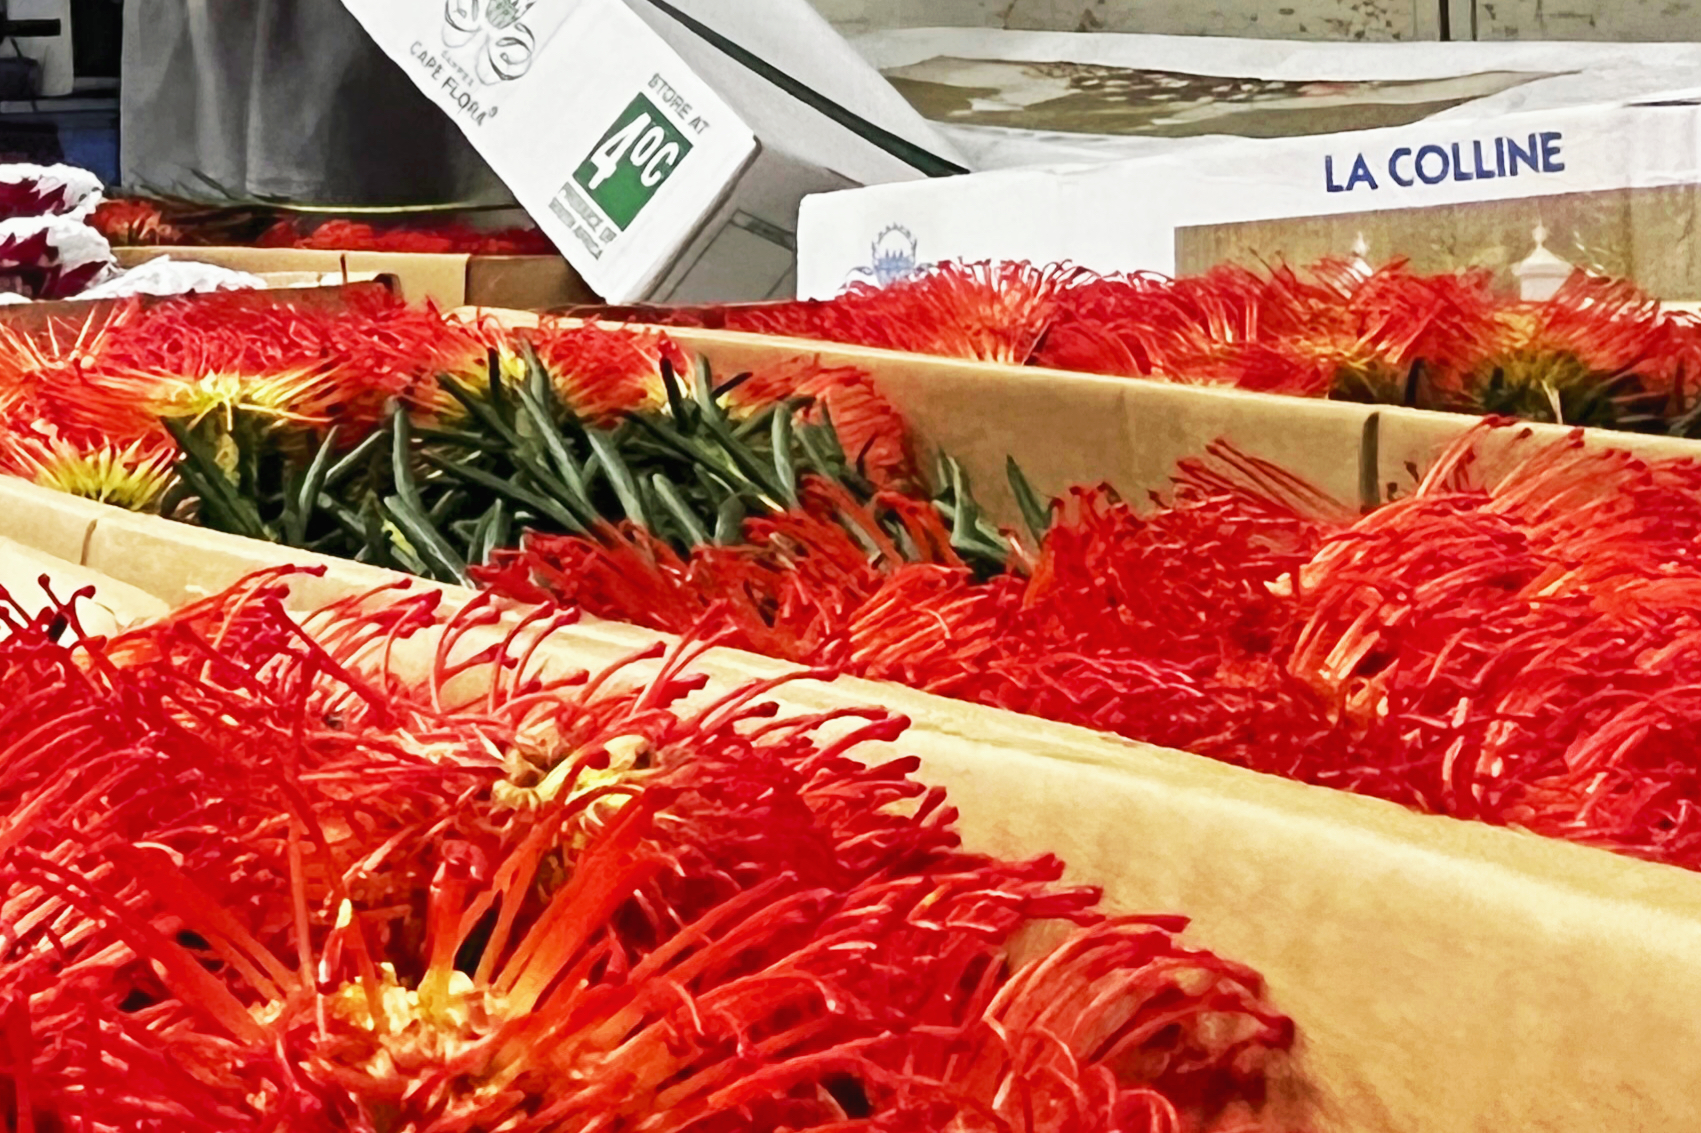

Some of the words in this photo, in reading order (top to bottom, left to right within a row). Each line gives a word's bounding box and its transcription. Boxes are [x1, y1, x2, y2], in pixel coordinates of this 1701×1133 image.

[410, 40, 444, 81] CAPE
[648, 72, 692, 121] STORE
[688, 116, 710, 135] AT
[1324, 152, 1379, 193] LA
[1388, 131, 1566, 187] COLLINE
